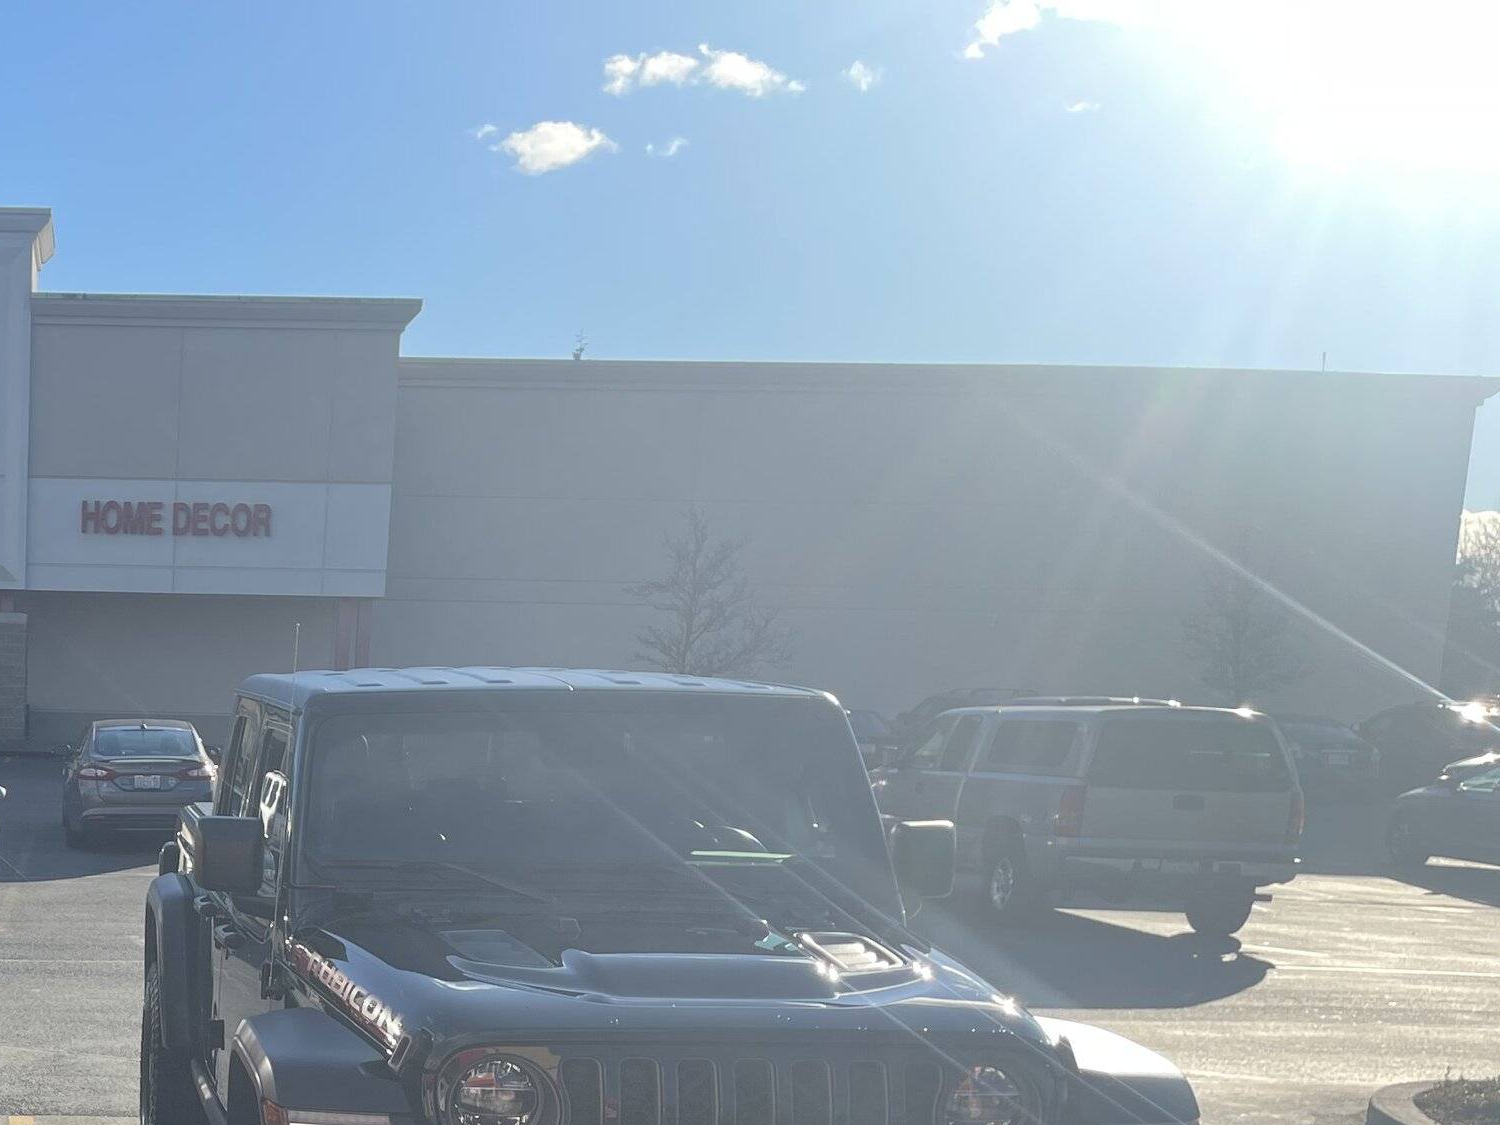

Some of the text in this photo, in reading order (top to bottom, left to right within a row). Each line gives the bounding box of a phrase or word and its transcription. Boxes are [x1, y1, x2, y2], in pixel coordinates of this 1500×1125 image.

[80, 500, 271, 537] HOME DECOR
[306, 951, 405, 1037] RUBICON
